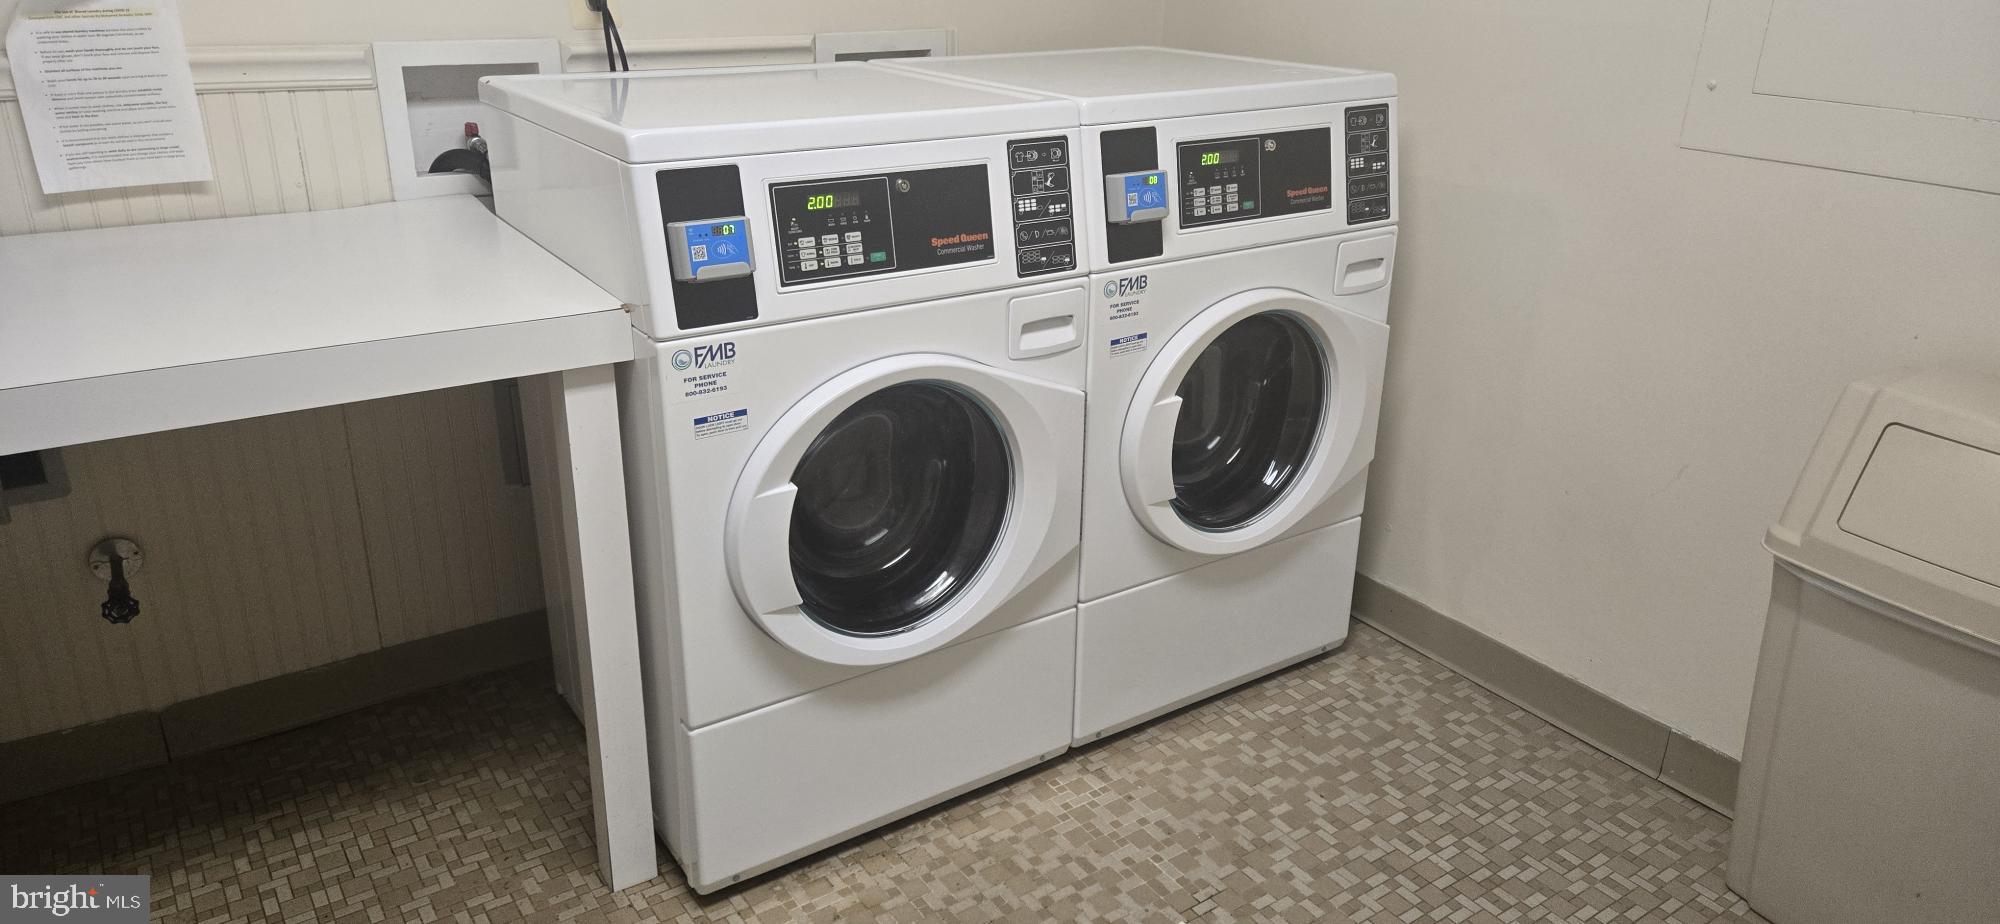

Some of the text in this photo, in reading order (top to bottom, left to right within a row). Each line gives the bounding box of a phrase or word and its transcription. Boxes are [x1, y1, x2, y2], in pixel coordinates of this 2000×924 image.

[1202, 153, 1220, 166] 2.00
[1149, 175, 1158, 185] 08
[1286, 186, 1328, 198] Speed Queen
[807, 195, 833, 210] 2.00
[723, 224, 735, 235] 07
[931, 232, 989, 248] Speed Queen
[937, 243, 985, 256] Commercial Washer
[1119, 274, 1148, 298] FMB
[1120, 299, 1140, 308] SERVICE
[694, 341, 737, 369] FMB
[704, 359, 736, 369] LAUNDRY
[683, 371, 727, 384] FOR SERVICE
[694, 380, 718, 389] PHONE
[685, 385, 728, 398] 800-832-6193
[707, 411, 735, 423] NOTICE
